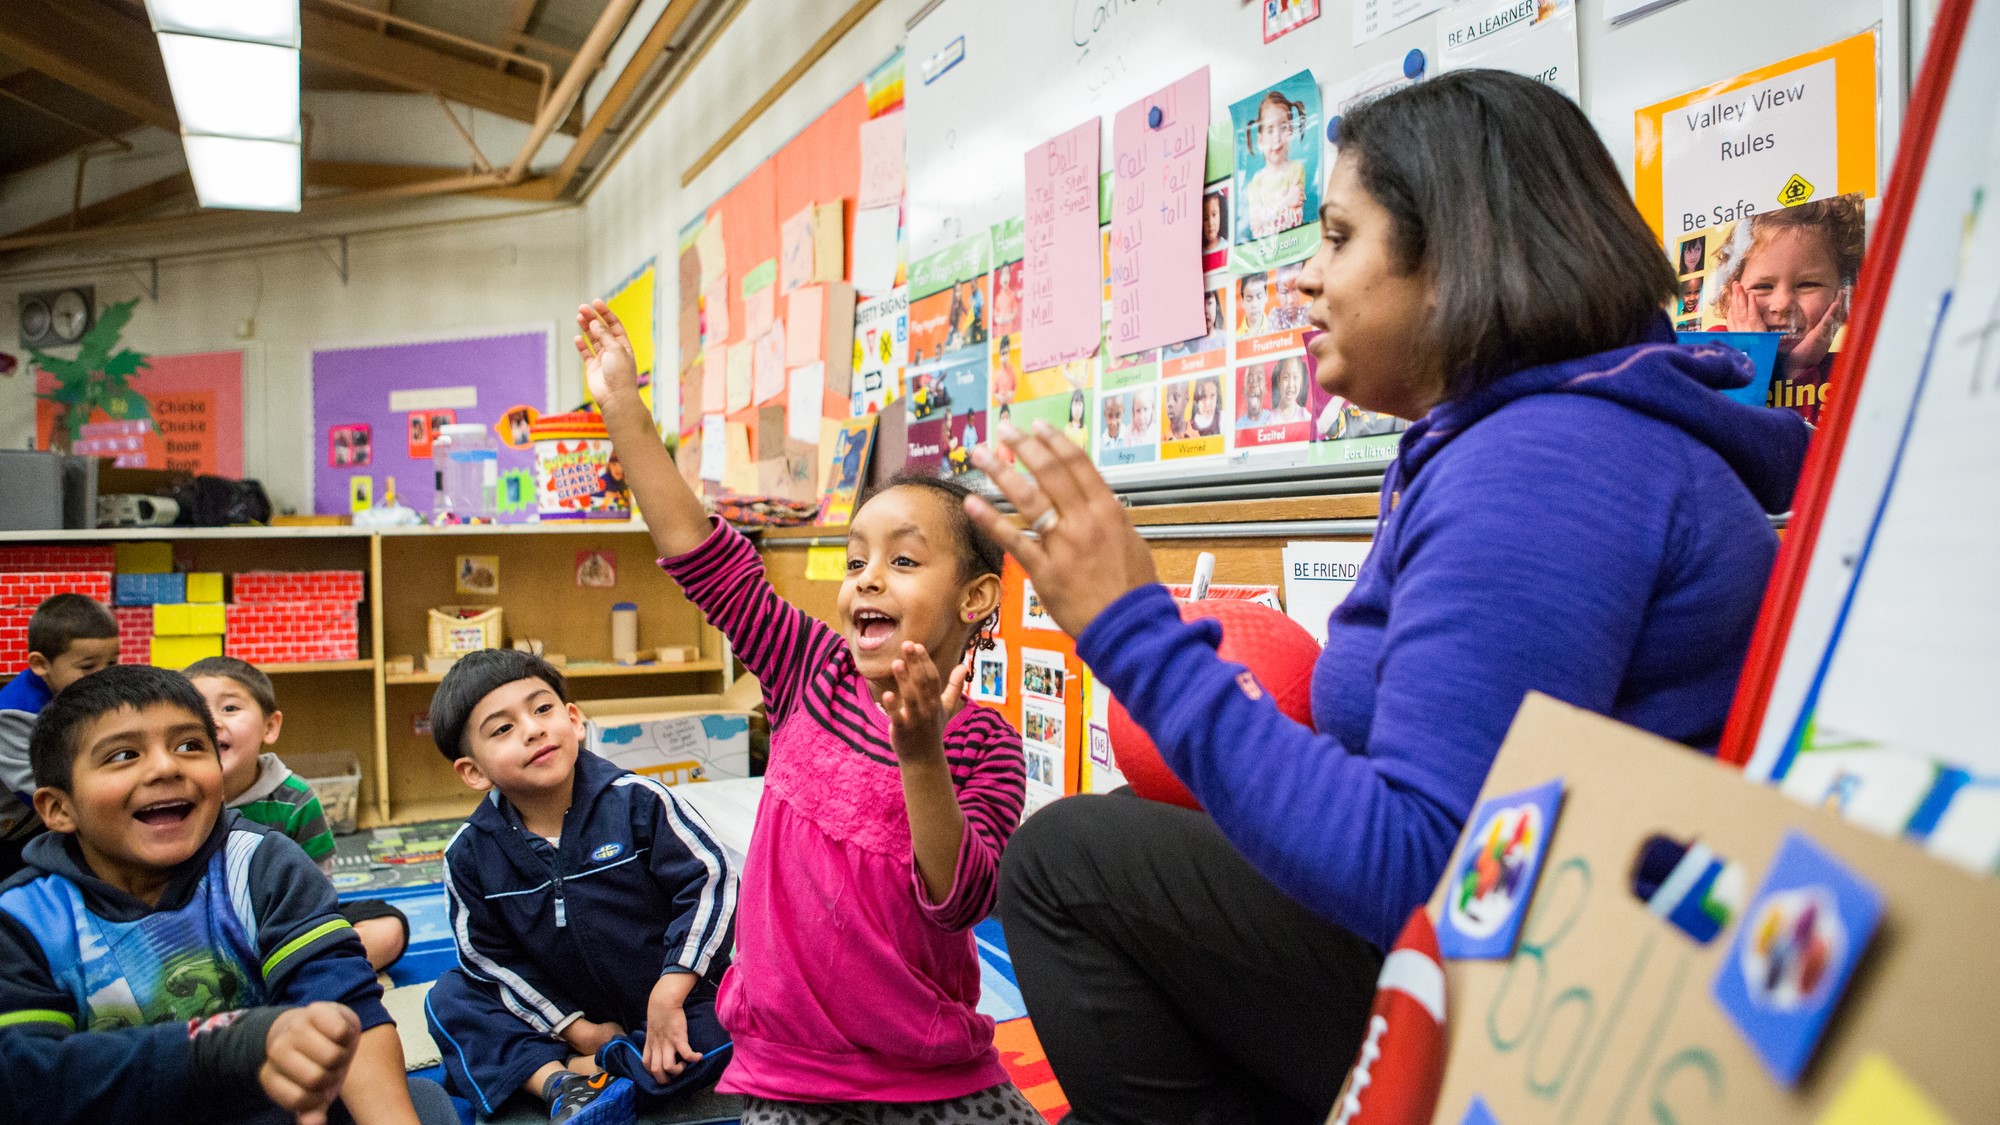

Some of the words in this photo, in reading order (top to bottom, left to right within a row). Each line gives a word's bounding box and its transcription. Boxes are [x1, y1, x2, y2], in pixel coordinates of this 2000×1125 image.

[1448, 29, 1463, 47] BE
[1467, 25, 1476, 40] A
[1479, 0, 1534, 35] LEARNER
[1686, 101, 1747, 132] Valley
[1752, 83, 1806, 112] View
[1048, 134, 1078, 177] Ball
[1118, 143, 1148, 180] Call
[1720, 133, 1776, 162] Rules
[1683, 212, 1706, 232] Be
[1712, 199, 1756, 226] Safe
[1112, 218, 1143, 254] Mall
[1112, 250, 1140, 287] Wall
[855, 304, 878, 325] AFETY
[1253, 333, 1294, 352] Frustrated
[1181, 355, 1205, 371] Scared
[1179, 441, 1207, 454] Worried
[1257, 427, 1286, 442] Excited
[1118, 451, 1136, 464] Angry
[1294, 563, 1310, 577] BE
[1313, 563, 1360, 578] FRIEND
